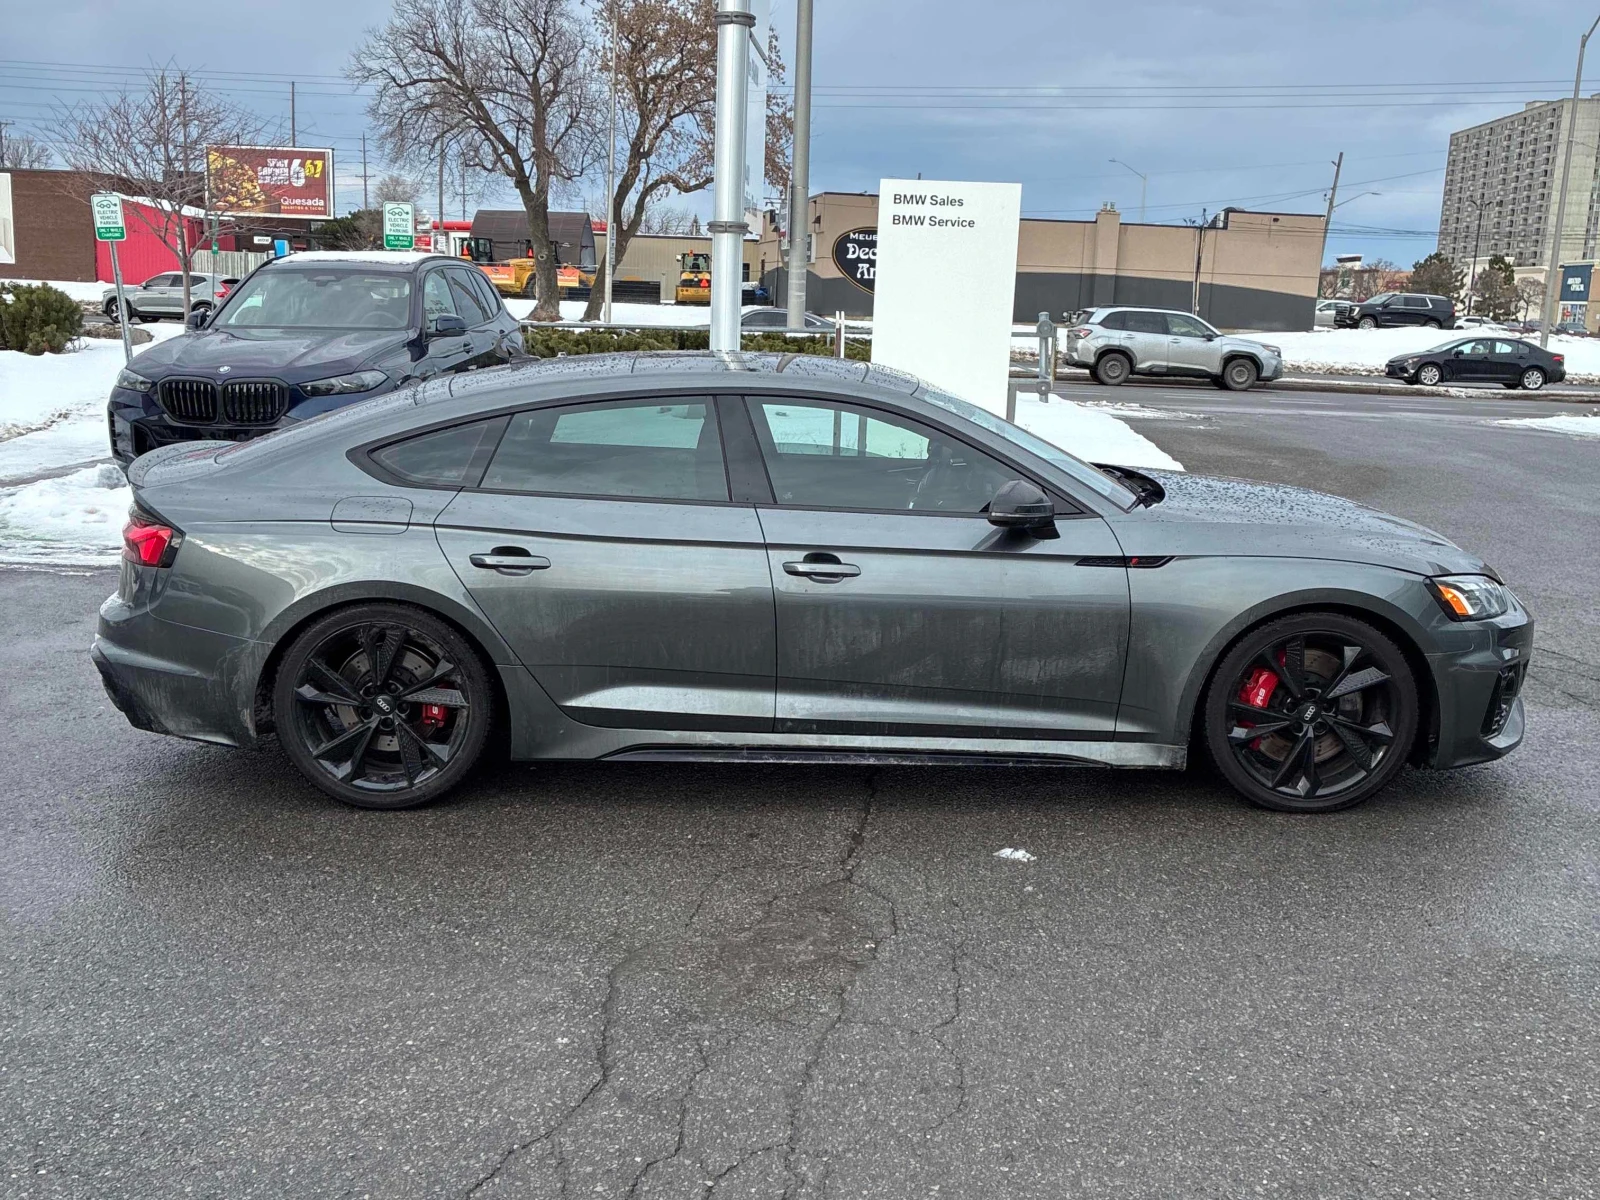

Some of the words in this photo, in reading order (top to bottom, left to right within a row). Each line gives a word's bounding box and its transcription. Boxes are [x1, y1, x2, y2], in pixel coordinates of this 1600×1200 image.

[281, 196, 325, 207] Quesada
[893, 193, 928, 206] BMW
[929, 194, 965, 208] Sales
[892, 214, 927, 226] BMW
[928, 215, 976, 228] Service
[1256, 687, 1266, 706] RS
